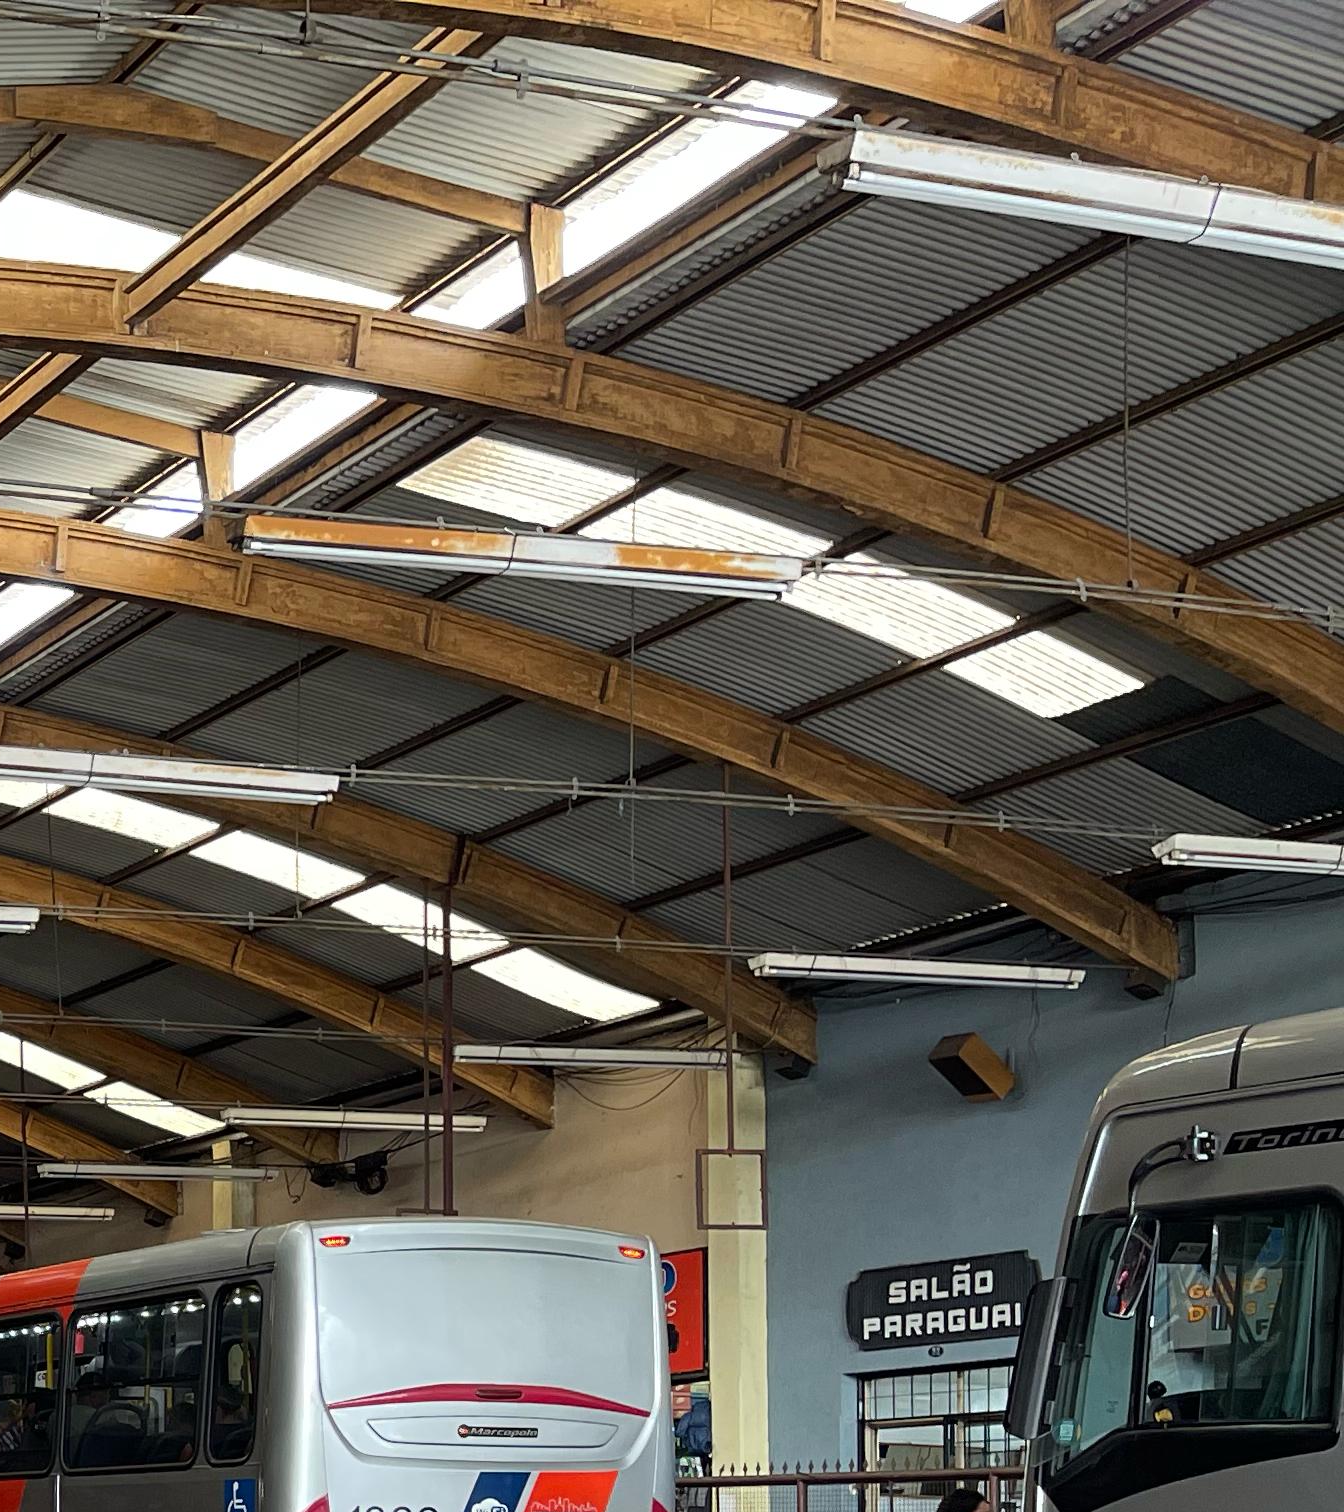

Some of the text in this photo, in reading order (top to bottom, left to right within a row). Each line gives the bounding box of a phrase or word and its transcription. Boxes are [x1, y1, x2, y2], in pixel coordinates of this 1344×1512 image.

[1233, 1126, 1344, 1151] Torin
[888, 1263, 994, 1304] SALÃO
[863, 1302, 1021, 1341] PARAGUAI
[471, 1427, 538, 1438] Marcopolo
